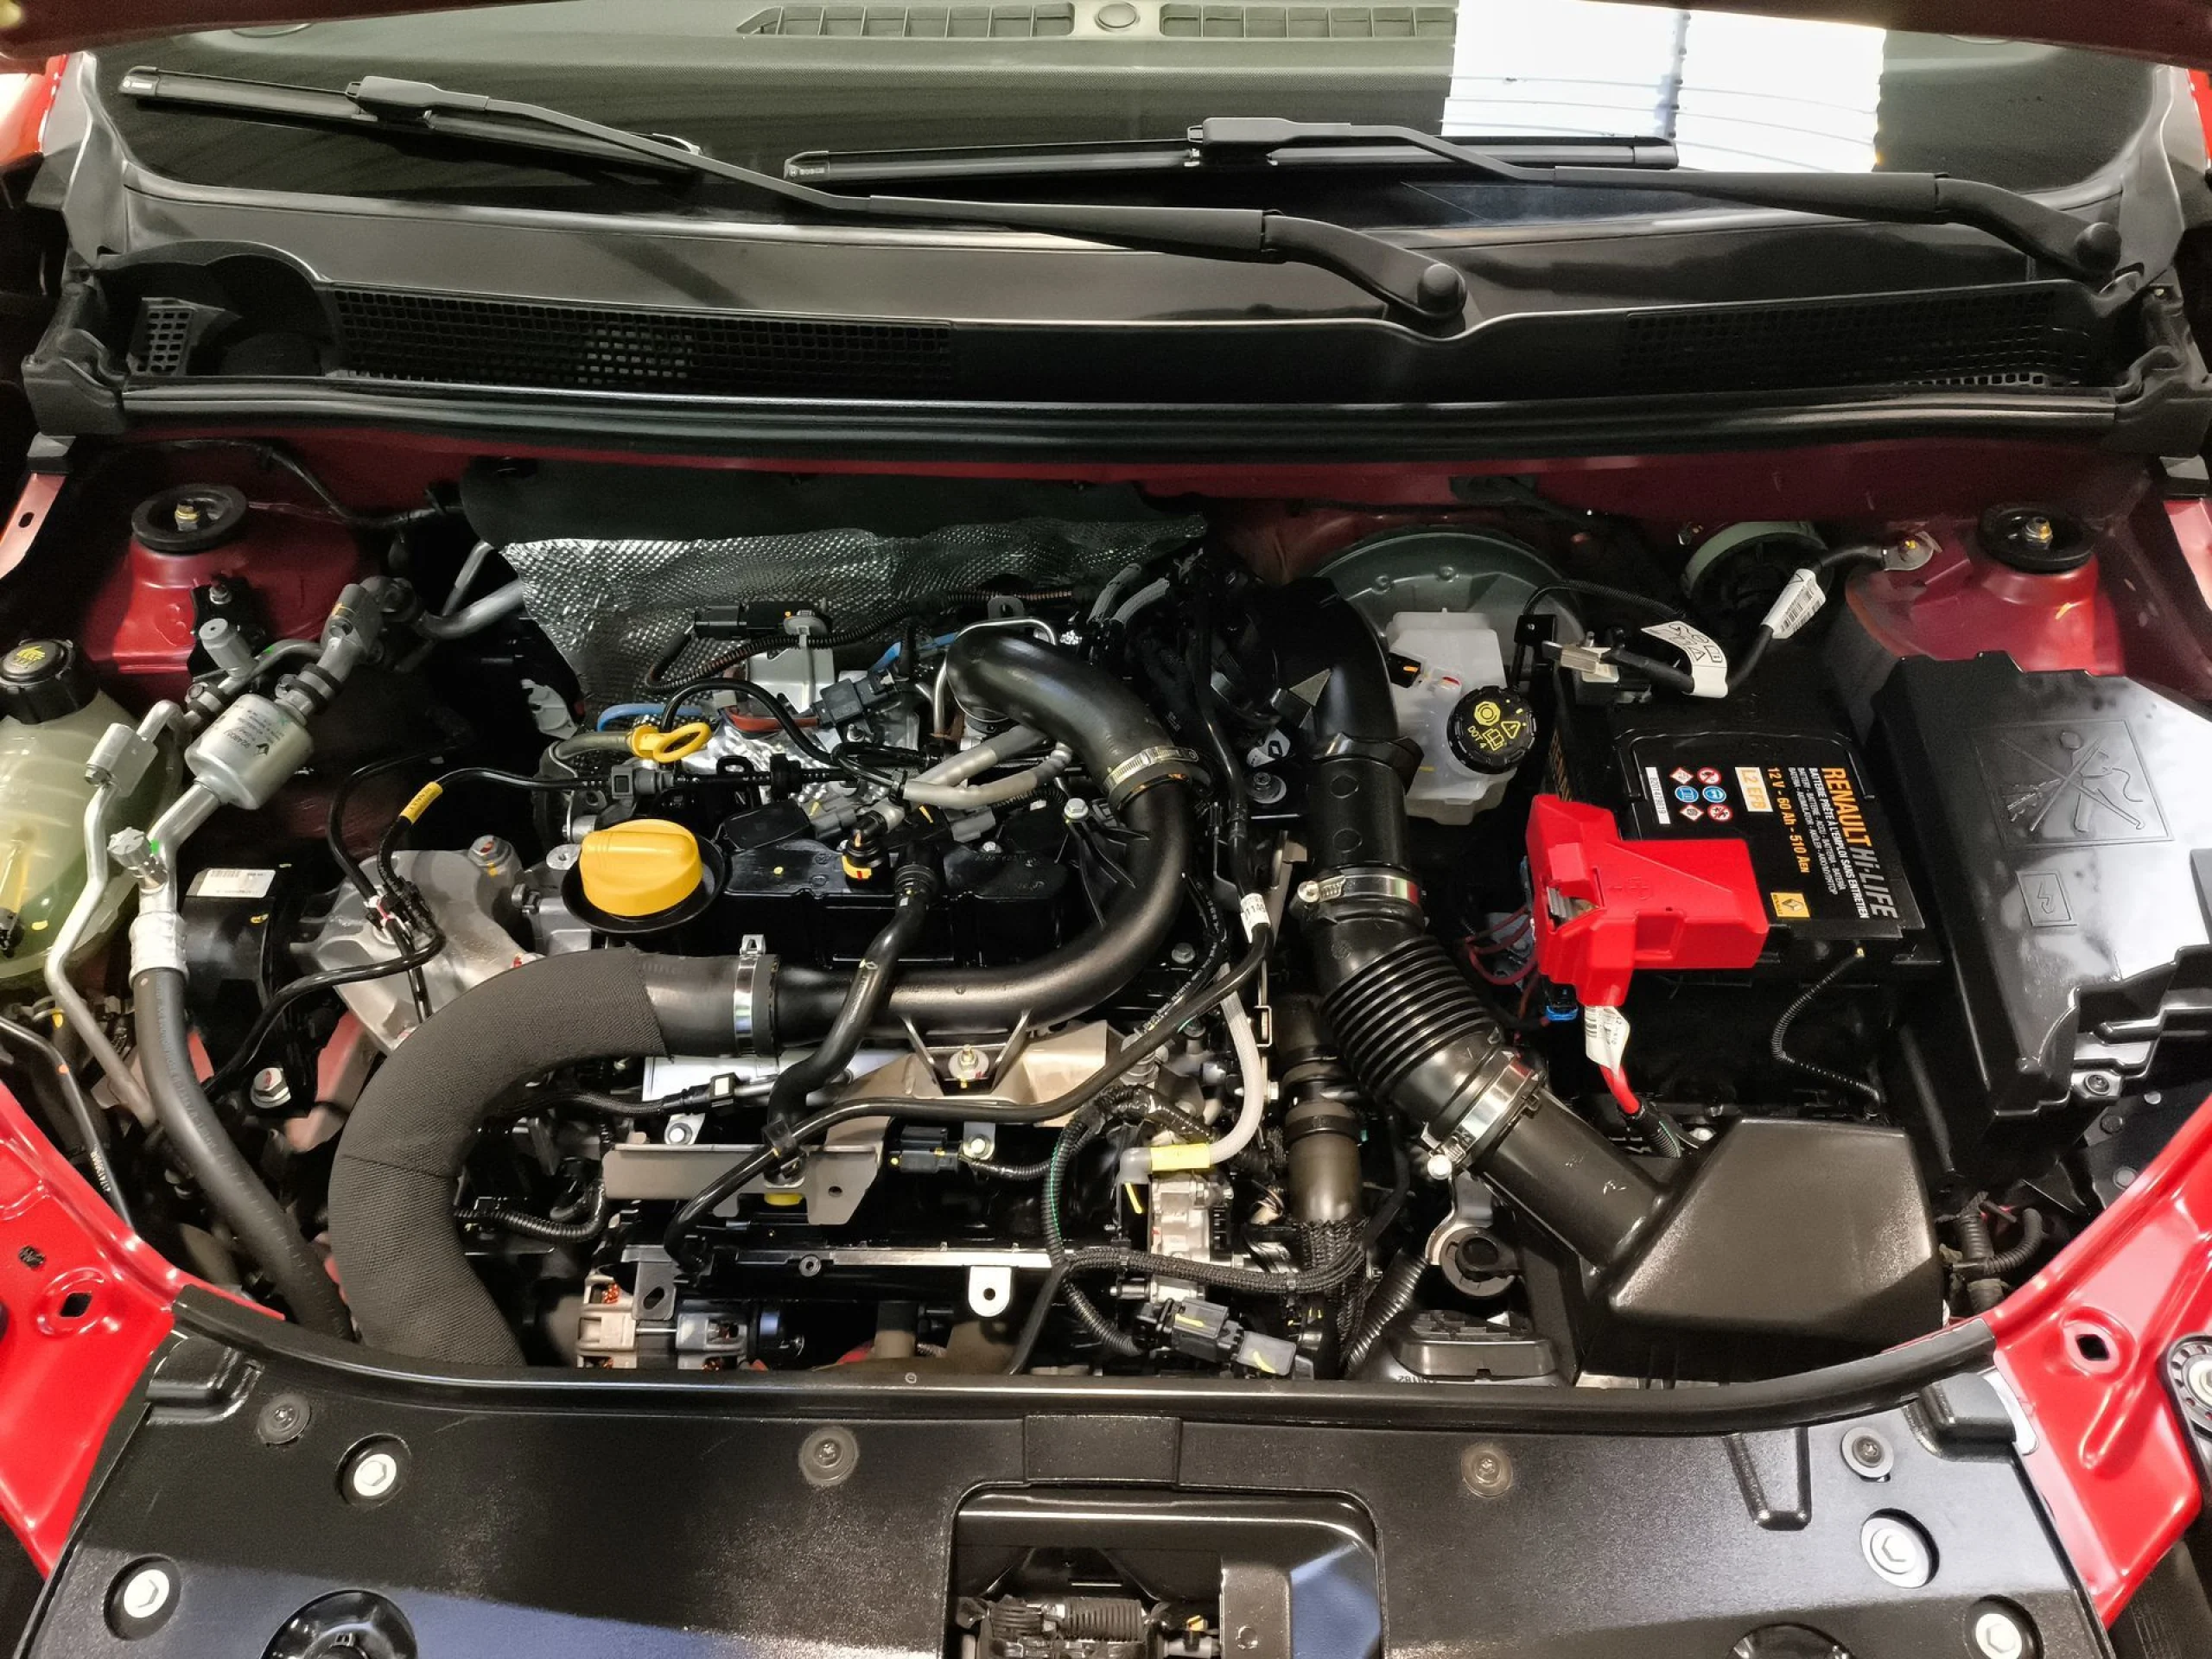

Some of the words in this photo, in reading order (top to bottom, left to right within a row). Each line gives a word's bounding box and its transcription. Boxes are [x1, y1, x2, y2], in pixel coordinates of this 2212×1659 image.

[1467, 726, 1484, 741] DOT
[1740, 770, 1760, 785] L2
[1767, 767, 1783, 779] 12
[1808, 767, 1827, 798] BATTERIE
[1747, 787, 1766, 809] EFB
[1797, 767, 1811, 789] BATTERY
[1806, 792, 1821, 816] BATTERIE
[1777, 798, 1791, 810] 60
[1819, 798, 1835, 820] PRÊTE
[1821, 767, 1872, 848] RENAULT
[1782, 811, 1796, 825] Ah
[1789, 834, 1808, 854] 510
[1828, 827, 1847, 859] L'EMPLOI
[1840, 858, 1857, 880] SANS
[1848, 880, 1870, 918] ENTRETIEN
